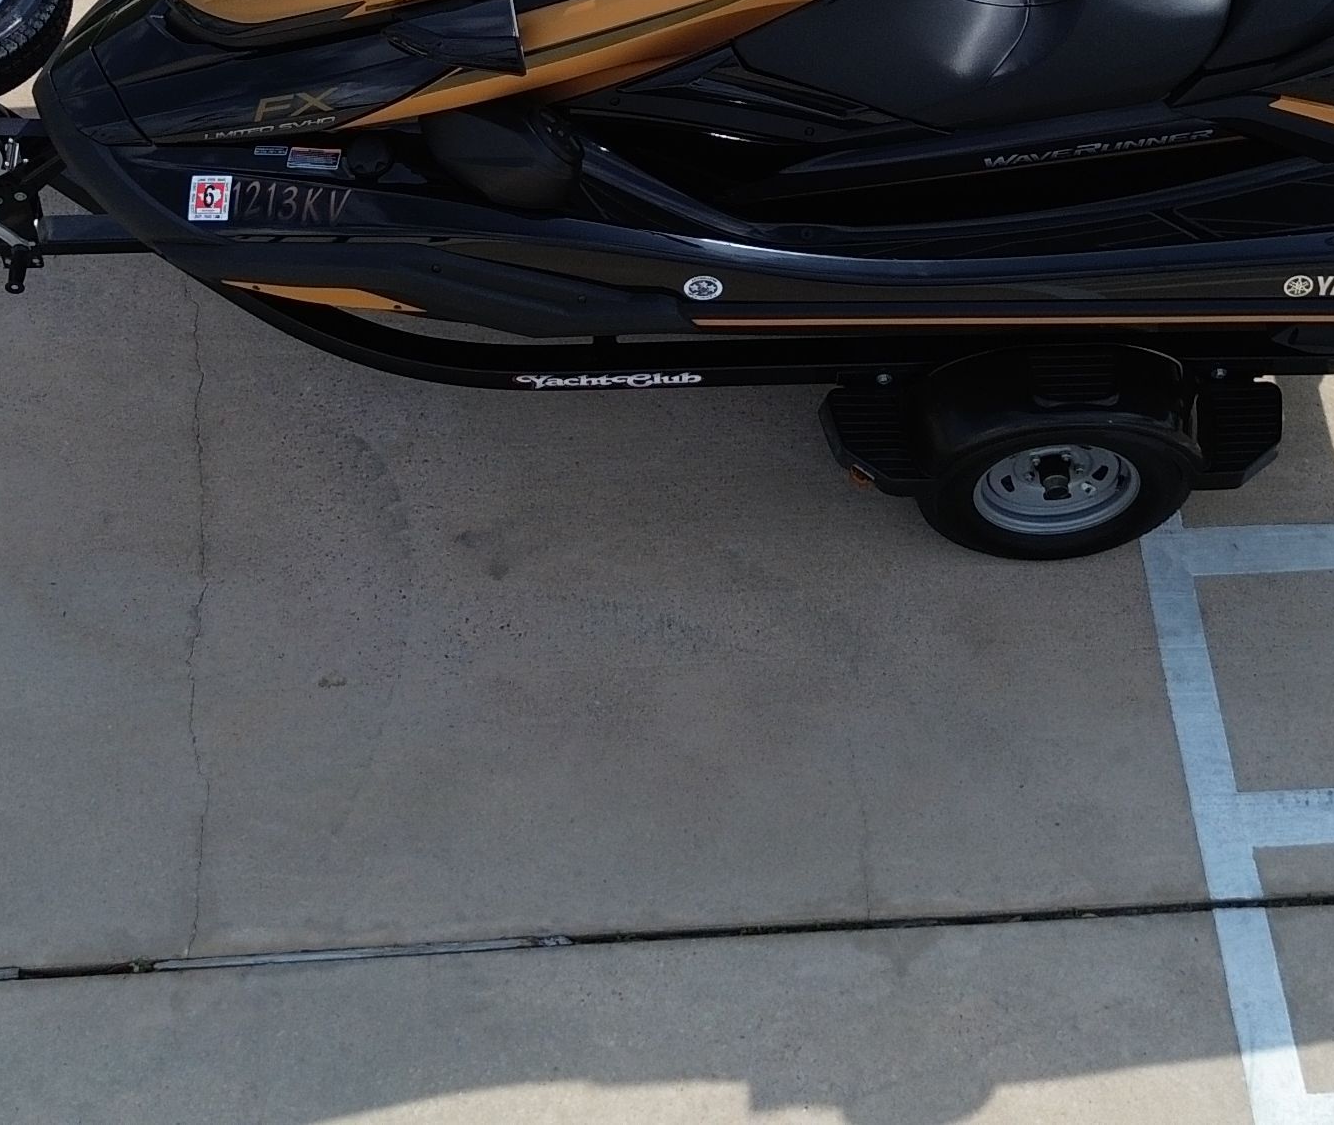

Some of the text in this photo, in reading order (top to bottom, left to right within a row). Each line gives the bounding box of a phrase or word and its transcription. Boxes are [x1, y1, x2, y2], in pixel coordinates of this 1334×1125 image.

[253, 87, 338, 123] FX
[203, 184, 216, 208] 6
[232, 180, 353, 222] 1213KV
